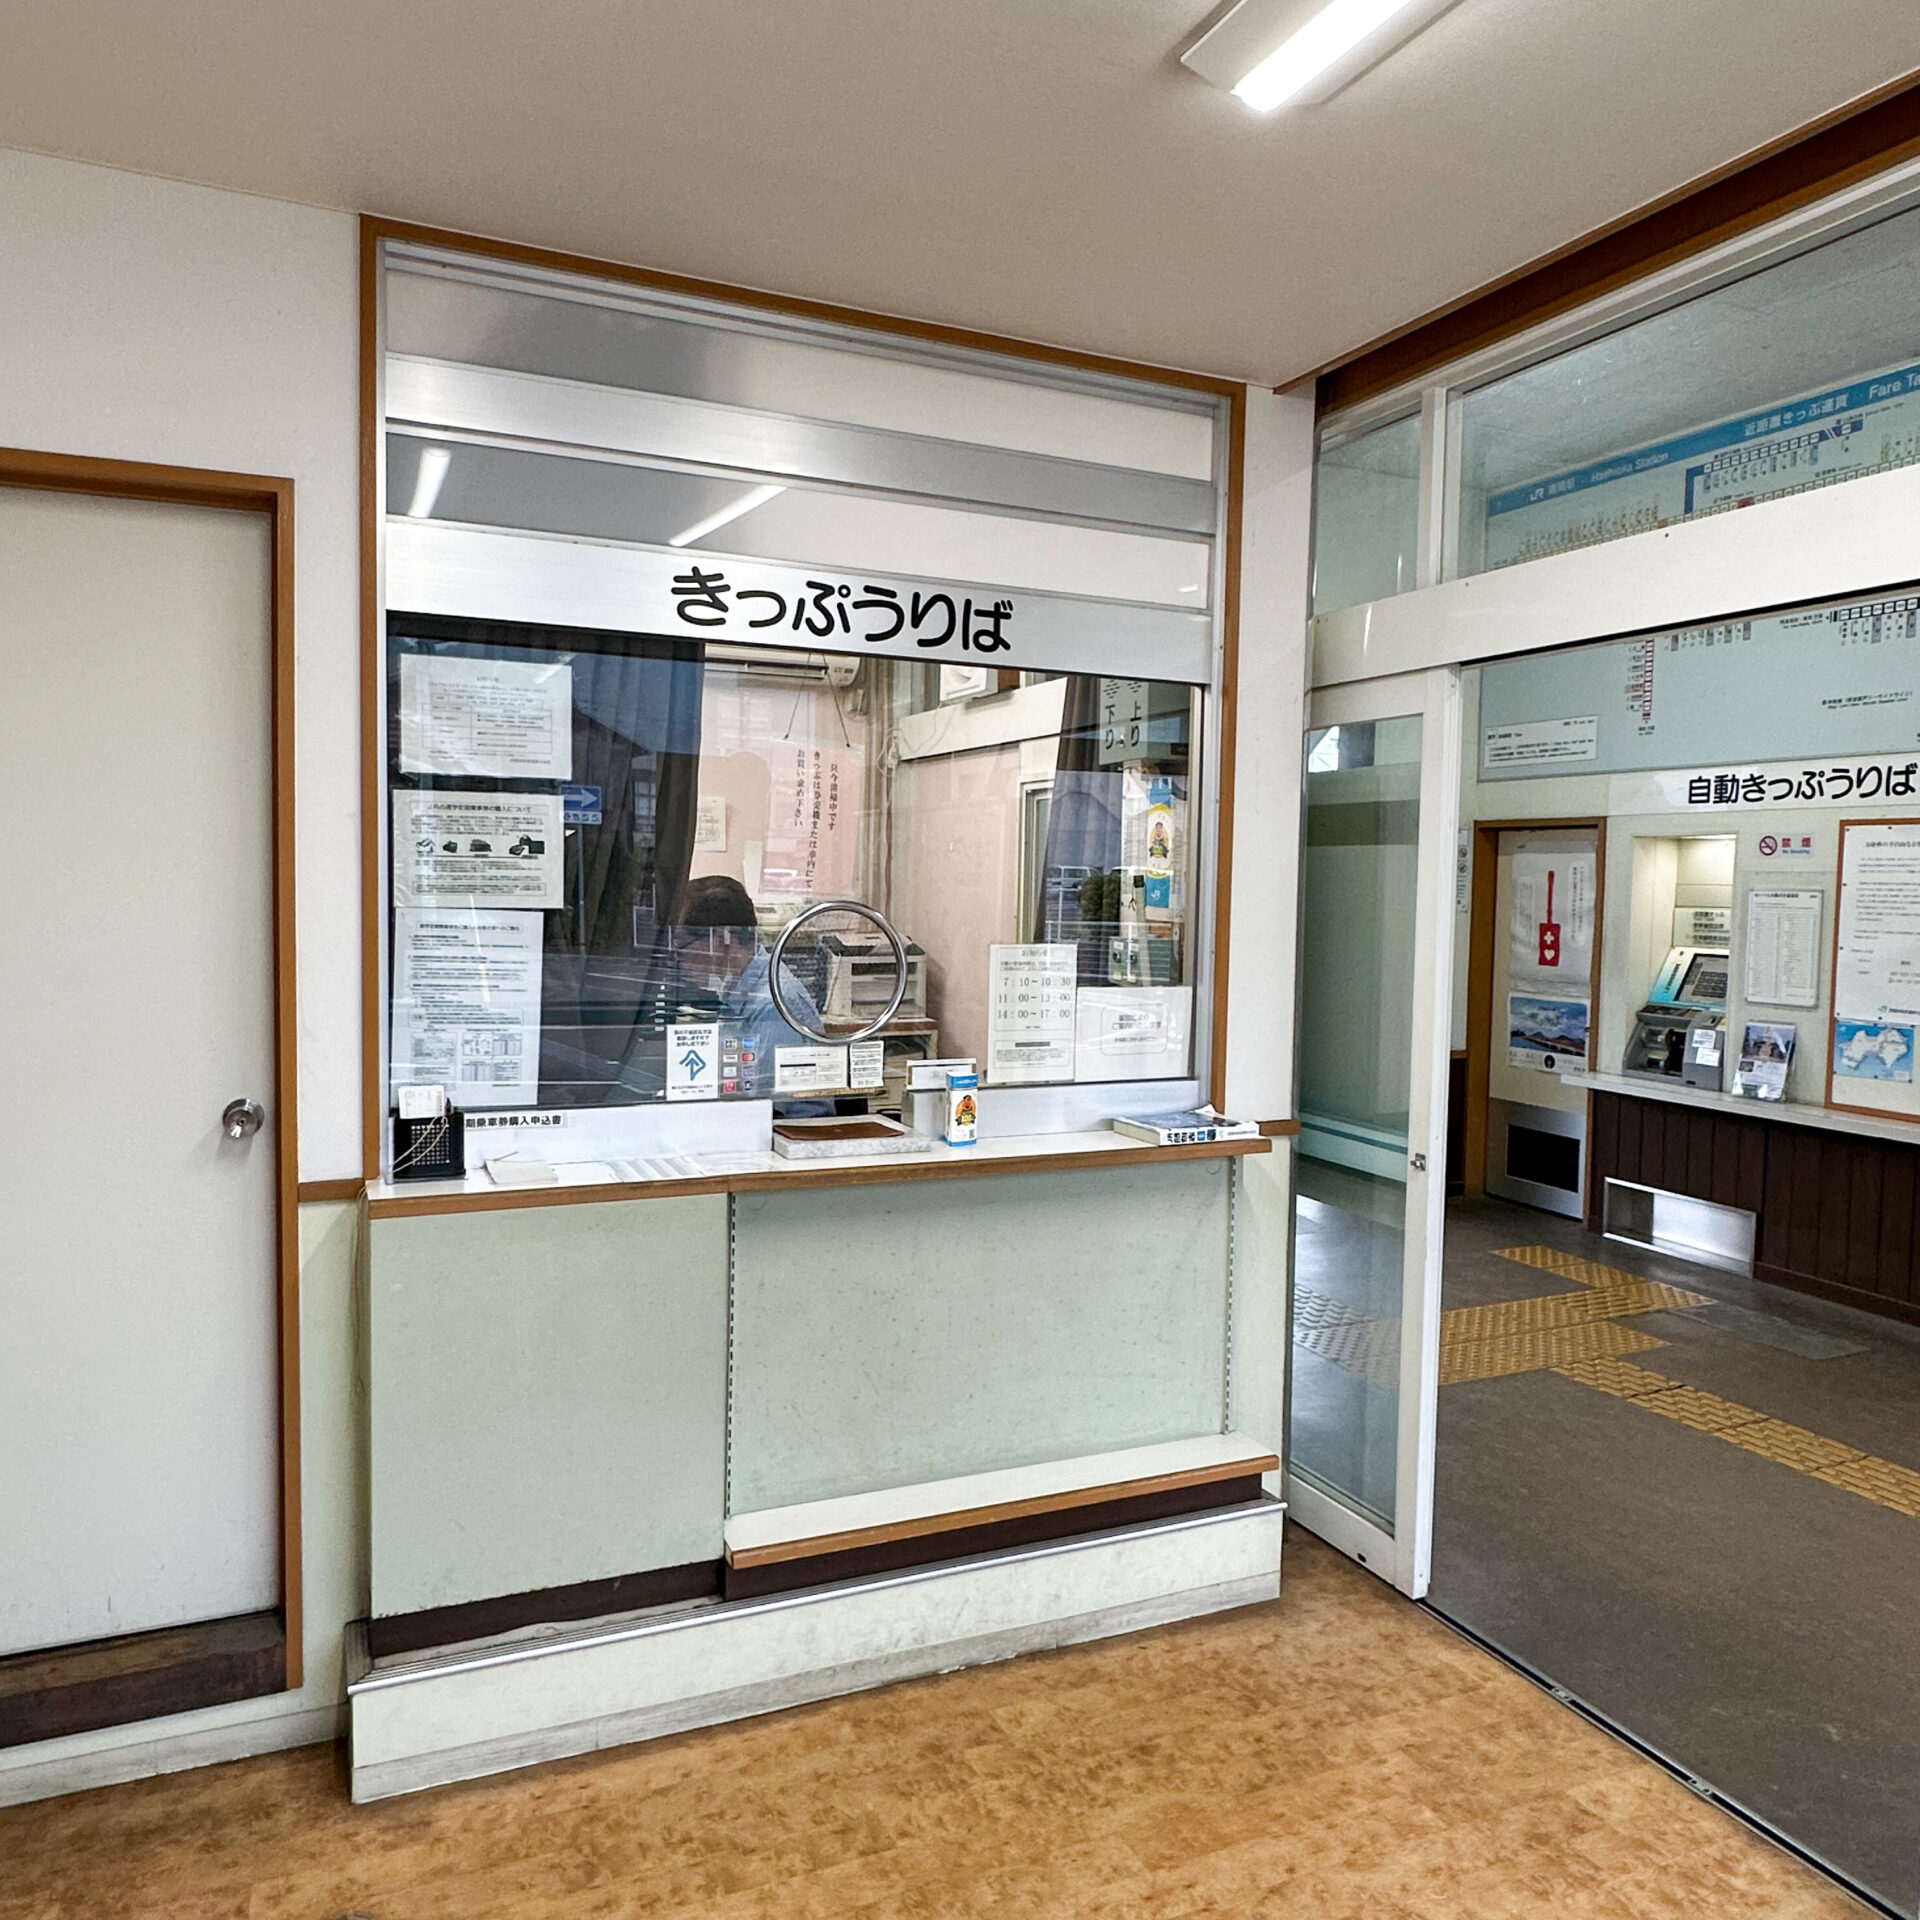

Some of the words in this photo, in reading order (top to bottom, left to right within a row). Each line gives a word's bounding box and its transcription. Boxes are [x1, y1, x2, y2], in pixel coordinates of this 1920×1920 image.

[1868, 381, 1901, 400] Fare
[1634, 453, 1669, 470] Station
[1529, 488, 1545, 501] JR
[671, 566, 1014, 653] きっぷうりば
[1104, 704, 1116, 750] 下り
[1129, 700, 1142, 747] 上り
[1687, 762, 1918, 804] 自動きっぷうりば
